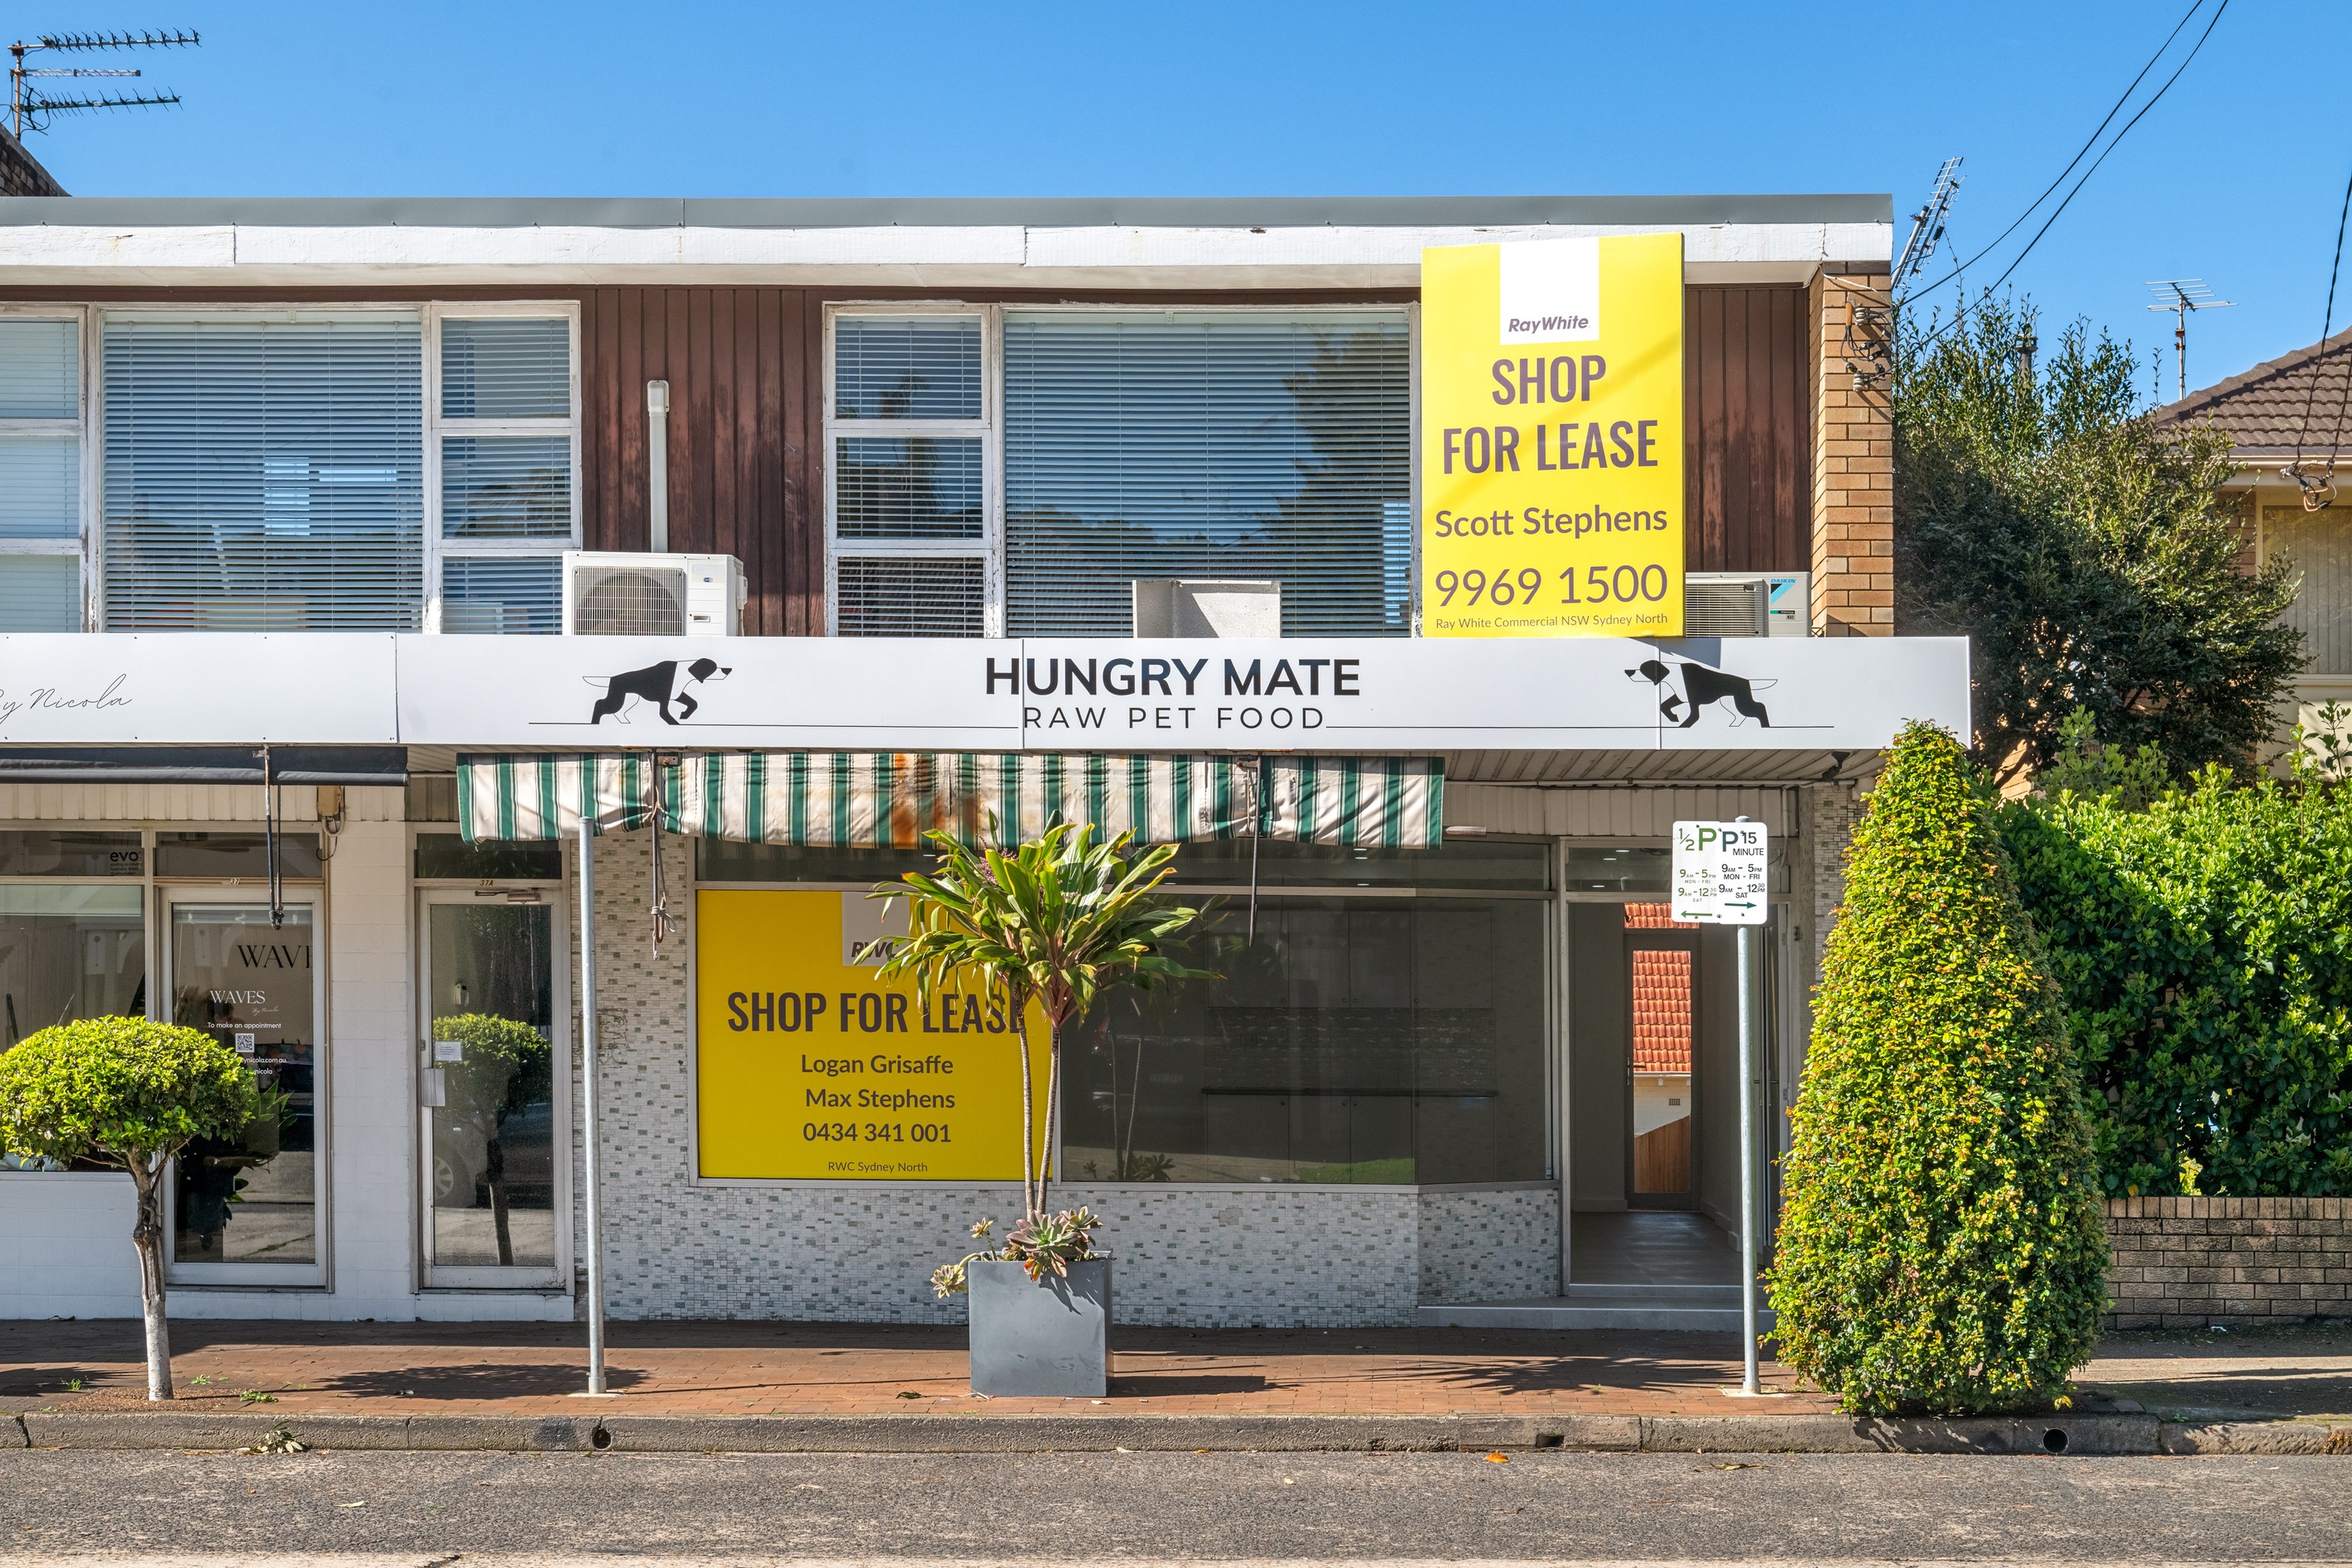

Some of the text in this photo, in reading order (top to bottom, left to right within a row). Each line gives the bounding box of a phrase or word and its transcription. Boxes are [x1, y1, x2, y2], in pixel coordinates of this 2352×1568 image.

[1493, 355, 1606, 405] SHOP
[1444, 420, 1657, 474] FOR LEASE
[1436, 505, 1667, 538] Scott Stephens
[1436, 565, 1667, 606] 9969 1500
[1437, 613, 1667, 630] Ray White Commercial NSW Sydney North
[986, 658, 1359, 696] HUNGRY MATE
[0, 674, 132, 724] y Nicola
[1024, 707, 1322, 729] RAW PET FOOD
[109, 851, 139, 863] evo
[1679, 868, 1694, 878] 9AM
[1701, 868, 1716, 878] 5PM
[1721, 863, 1736, 873] 9AM
[1748, 863, 1763, 873] 5PM
[1678, 887, 1691, 897] 9AM
[1719, 883, 1733, 893] 9AM
[209, 990, 266, 1004] WAVES
[729, 992, 826, 1032] SHOP
[839, 992, 909, 1032] FOR
[243, 1022, 281, 1031] appointment
[802, 1055, 953, 1076] Logan Grisaffe
[806, 1089, 955, 1111] Max Stephens
[804, 1123, 950, 1142] 0434 341 001
[829, 1162, 927, 1172] RWC Sydney North
